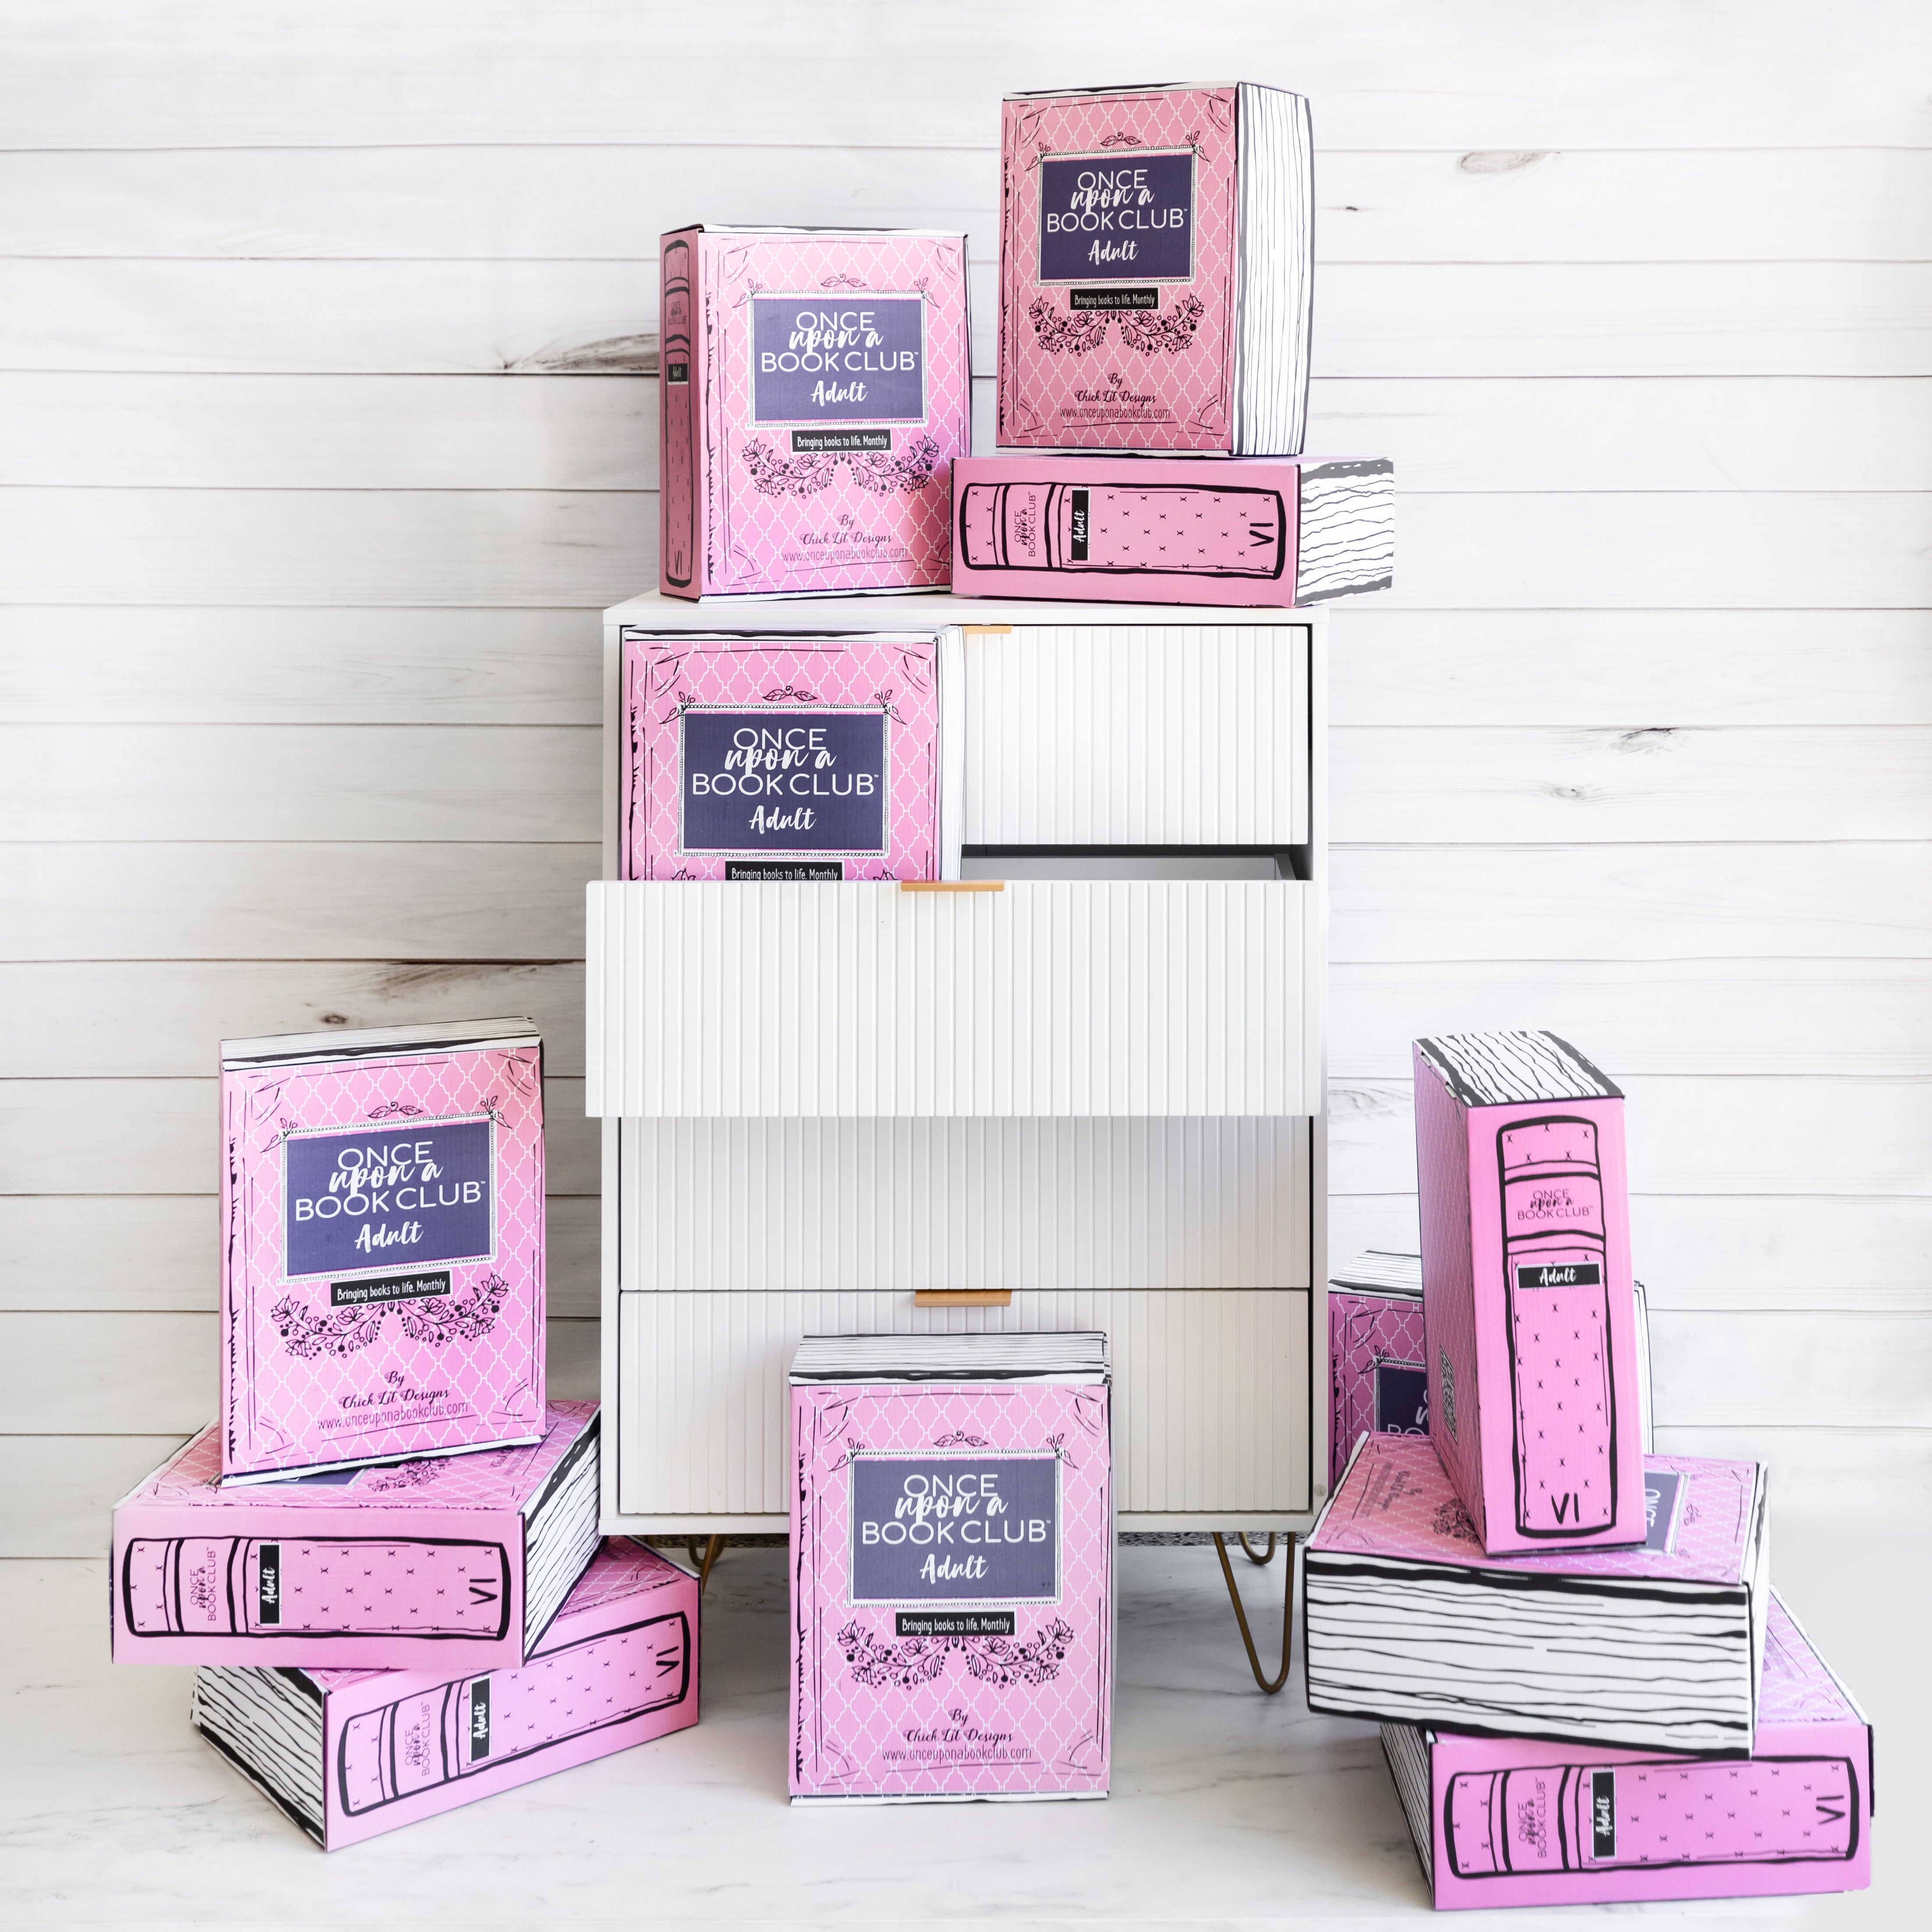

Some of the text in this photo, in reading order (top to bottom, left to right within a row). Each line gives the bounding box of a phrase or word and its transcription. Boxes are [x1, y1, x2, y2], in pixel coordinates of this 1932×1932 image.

[1078, 169, 1148, 191] ONCE
[1071, 188, 1155, 214] upon a
[1048, 211, 1114, 232] BOOK
[1088, 239, 1139, 265] Adult
[1075, 294, 1154, 308] Bringing books to life. Monthly
[796, 312, 875, 331] ONCE
[789, 329, 884, 353] upon a
[762, 352, 839, 372] BOOK
[1108, 373, 1122, 389] By
[811, 380, 868, 407] Adult
[1075, 390, 1157, 407] Chick Lit Designs
[1060, 405, 1170, 422] www.onceuponabookclub.com
[797, 435, 887, 450] Bringing books to life. Monthly
[838, 514, 854, 530] By
[1073, 510, 1087, 543] Adult
[800, 531, 892, 547] Chick Lit Designs
[1249, 523, 1274, 547] VI
[781, 545, 907, 564] www.onceuponabookclub.com
[733, 728, 827, 750] ONCE
[724, 748, 837, 777] upon a
[693, 773, 783, 796] BOOK
[749, 805, 817, 834] Adult
[732, 868, 838, 880] Bringing books to life. Monthly
[337, 1141, 433, 1171] ONCE
[329, 1162, 443, 1196] upon a
[295, 1190, 390, 1221] BOOK
[1533, 1189, 1570, 1200] ONCE
[1518, 1209, 1554, 1220] BOOK
[354, 1221, 424, 1254] Adult
[1539, 1267, 1577, 1287] Adult
[337, 1278, 446, 1302] Bringing books to life. Monthly
[384, 1371, 405, 1389] By
[339, 1388, 450, 1409] Chick Lit Designs
[318, 1401, 468, 1430] www.onceuponabookclub.com
[904, 1474, 998, 1498] ONCE
[895, 1494, 1009, 1524] upon a
[1551, 1492, 1579, 1524] VI
[862, 1521, 954, 1545] BOOK
[920, 1553, 988, 1584] Adult
[190, 1569, 199, 1605] ONCE
[469, 1579, 497, 1605] VI
[902, 1618, 1010, 1635] Bringing books to life. Monthly
[656, 1646, 680, 1678] VI
[948, 1708, 968, 1727] By
[405, 1729, 414, 1765] ONCE
[903, 1728, 1014, 1747] Chick Lit Designs
[422, 1739, 430, 1776] BOOK
[882, 1744, 1031, 1765] www.onceuponabookclub.com
[1815, 1795, 1846, 1825] VI
[1538, 1819, 1547, 1858] BOOK
